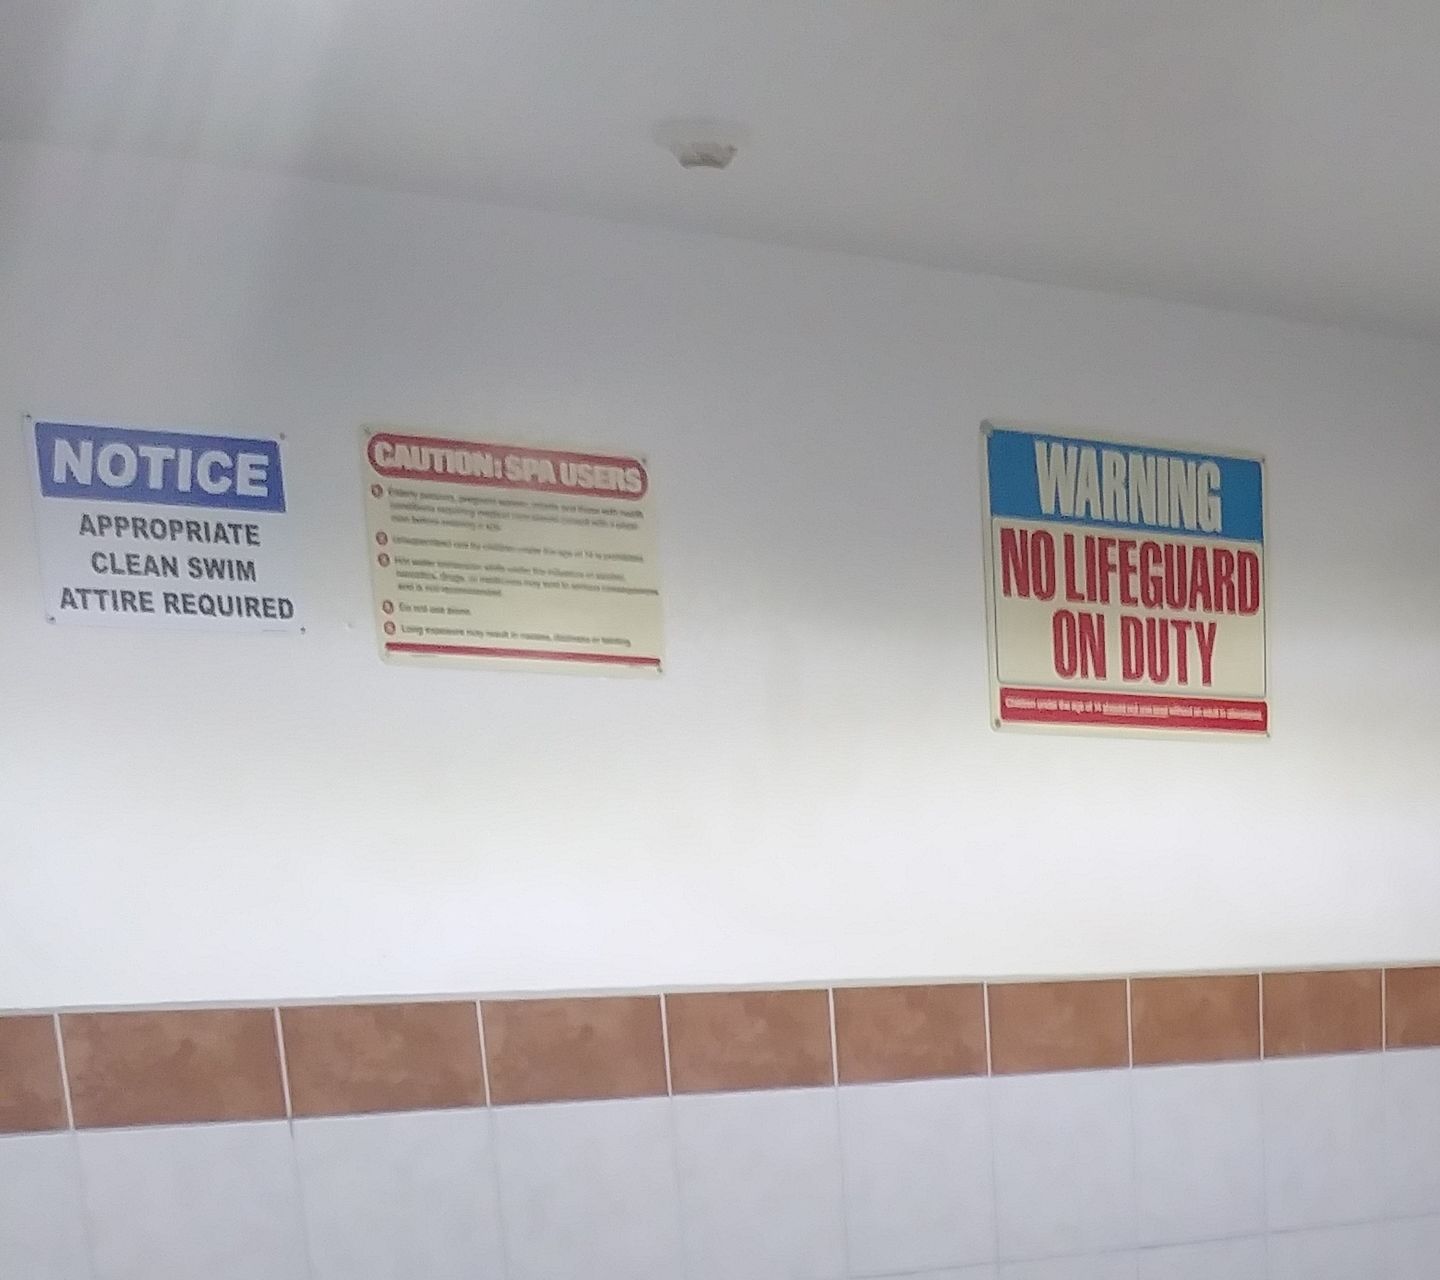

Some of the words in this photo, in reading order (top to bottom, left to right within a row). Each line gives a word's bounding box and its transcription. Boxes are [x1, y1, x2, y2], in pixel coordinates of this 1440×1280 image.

[53, 438, 270, 498] NOTICE
[503, 455, 557, 483] SPA
[560, 464, 643, 493] USERS
[1033, 438, 1224, 534] WARNING
[78, 512, 262, 547] APPROPRIATE
[91, 551, 180, 579] CLEAN
[187, 556, 258, 583] SWIM
[1000, 528, 1057, 601] NO
[1063, 533, 1261, 617] LIFEGUARD
[59, 586, 156, 615] ATTIRE
[163, 591, 295, 620] REQUIRED
[1051, 609, 1108, 681] ON
[1120, 614, 1218, 688] DUTY
